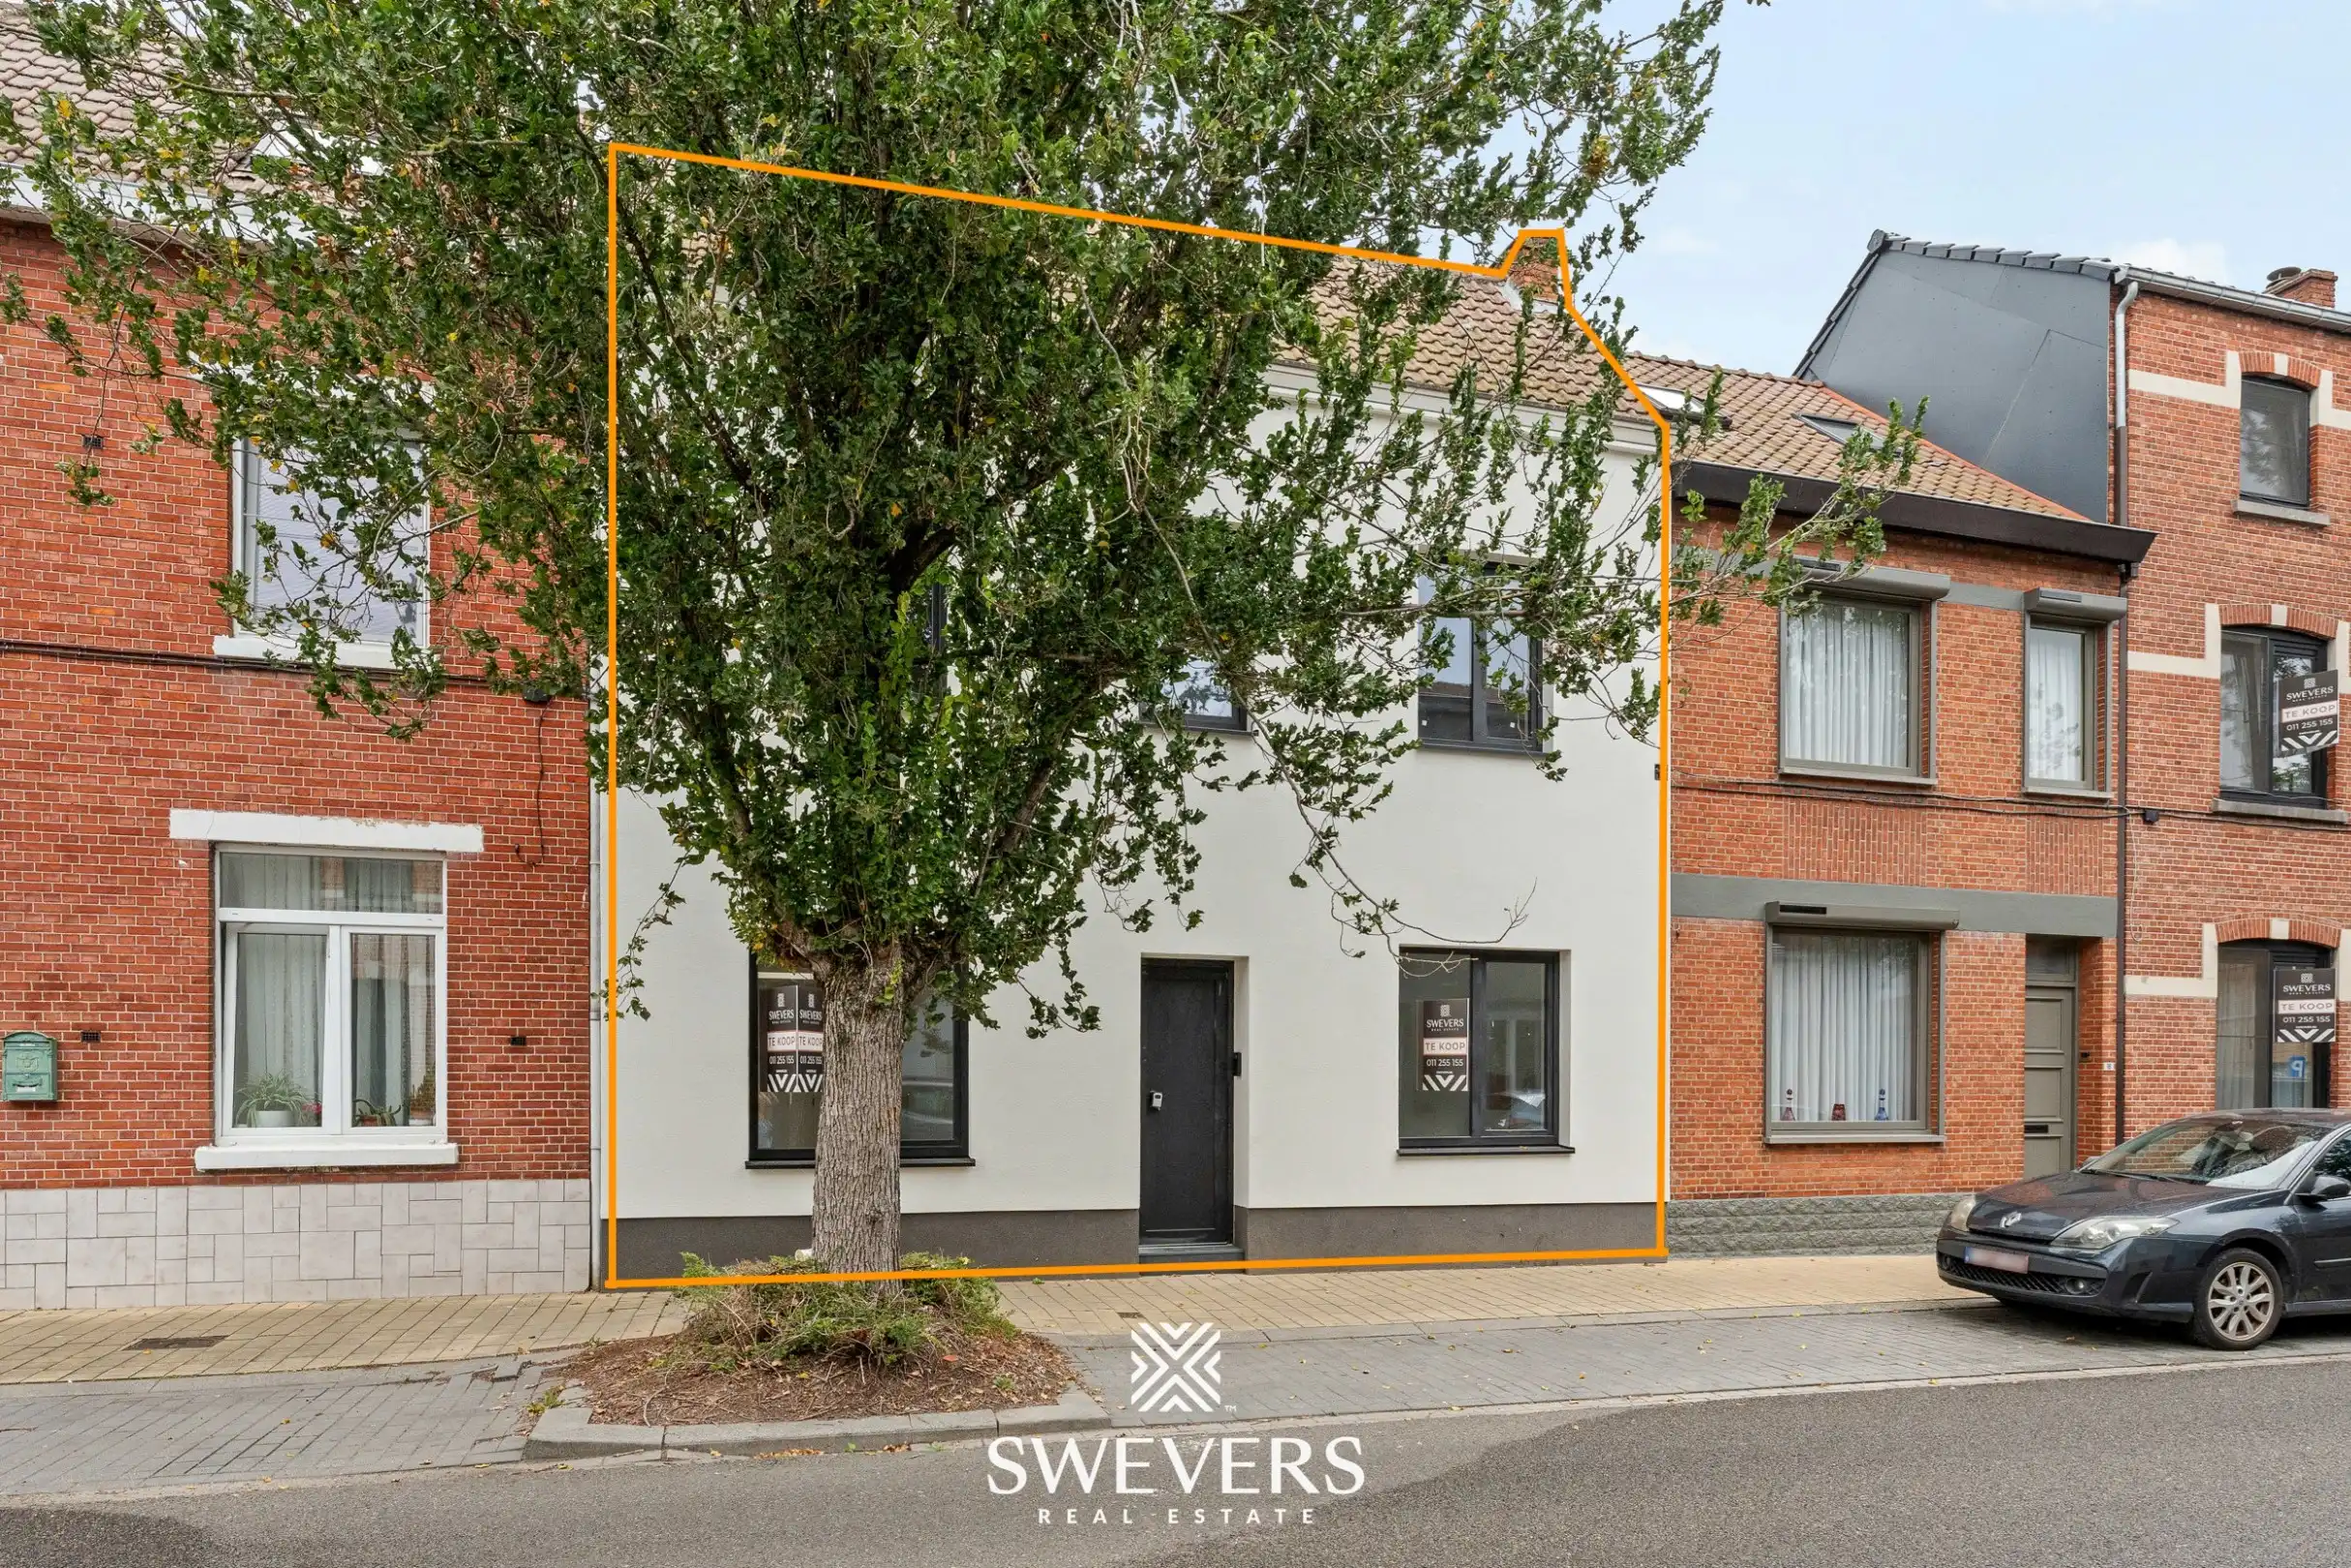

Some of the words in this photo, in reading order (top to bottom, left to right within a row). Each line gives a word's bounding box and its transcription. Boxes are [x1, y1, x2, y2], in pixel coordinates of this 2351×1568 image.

[2286, 685, 2334, 701] SWEVERS
[2303, 705, 2335, 715] KOOP
[2319, 718, 2333, 727] 155
[2282, 983, 2331, 992] SWEVERS
[769, 1010, 794, 1020] SWEVERS
[799, 1010, 823, 1021] SWEVERS
[1426, 1018, 1464, 1028] SWEVERS
[769, 1037, 776, 1046] TE
[777, 1037, 796, 1046] KOOP
[799, 1036, 806, 1046] TE
[1425, 1042, 1435, 1051] TE
[777, 1055, 786, 1065] 255
